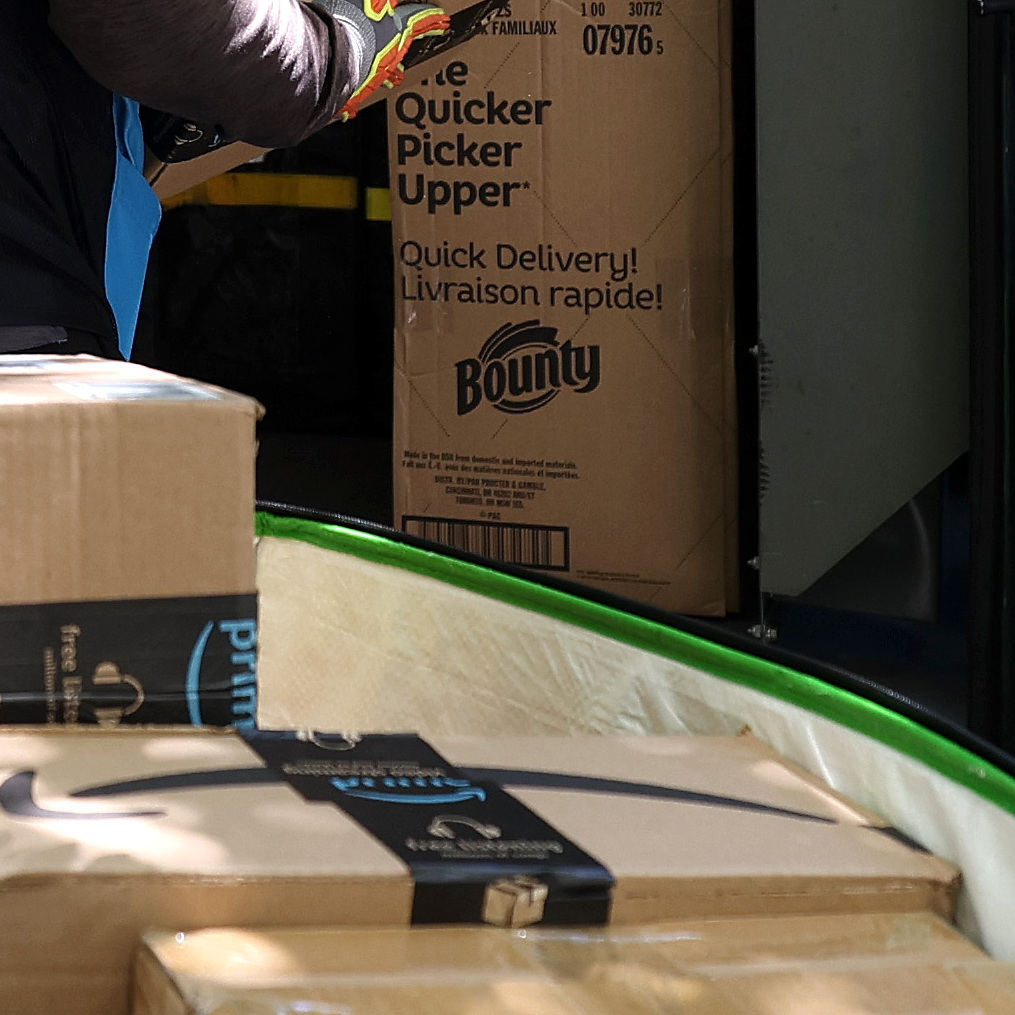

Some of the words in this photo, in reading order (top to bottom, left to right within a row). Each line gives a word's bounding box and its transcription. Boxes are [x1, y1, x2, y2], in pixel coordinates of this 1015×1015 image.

[628, 1, 663, 17] 30772
[492, 21, 557, 35] FAMILIAUX
[583, 24, 653, 55] 07976
[395, 91, 552, 129] Quicker
[397, 133, 522, 167] Picker
[400, 240, 487, 270] Quick
[496, 244, 638, 282] Delivery!
[401, 275, 540, 305] Livraison
[550, 282, 663, 315] rapide!
[455, 338, 601, 416] Bounty
